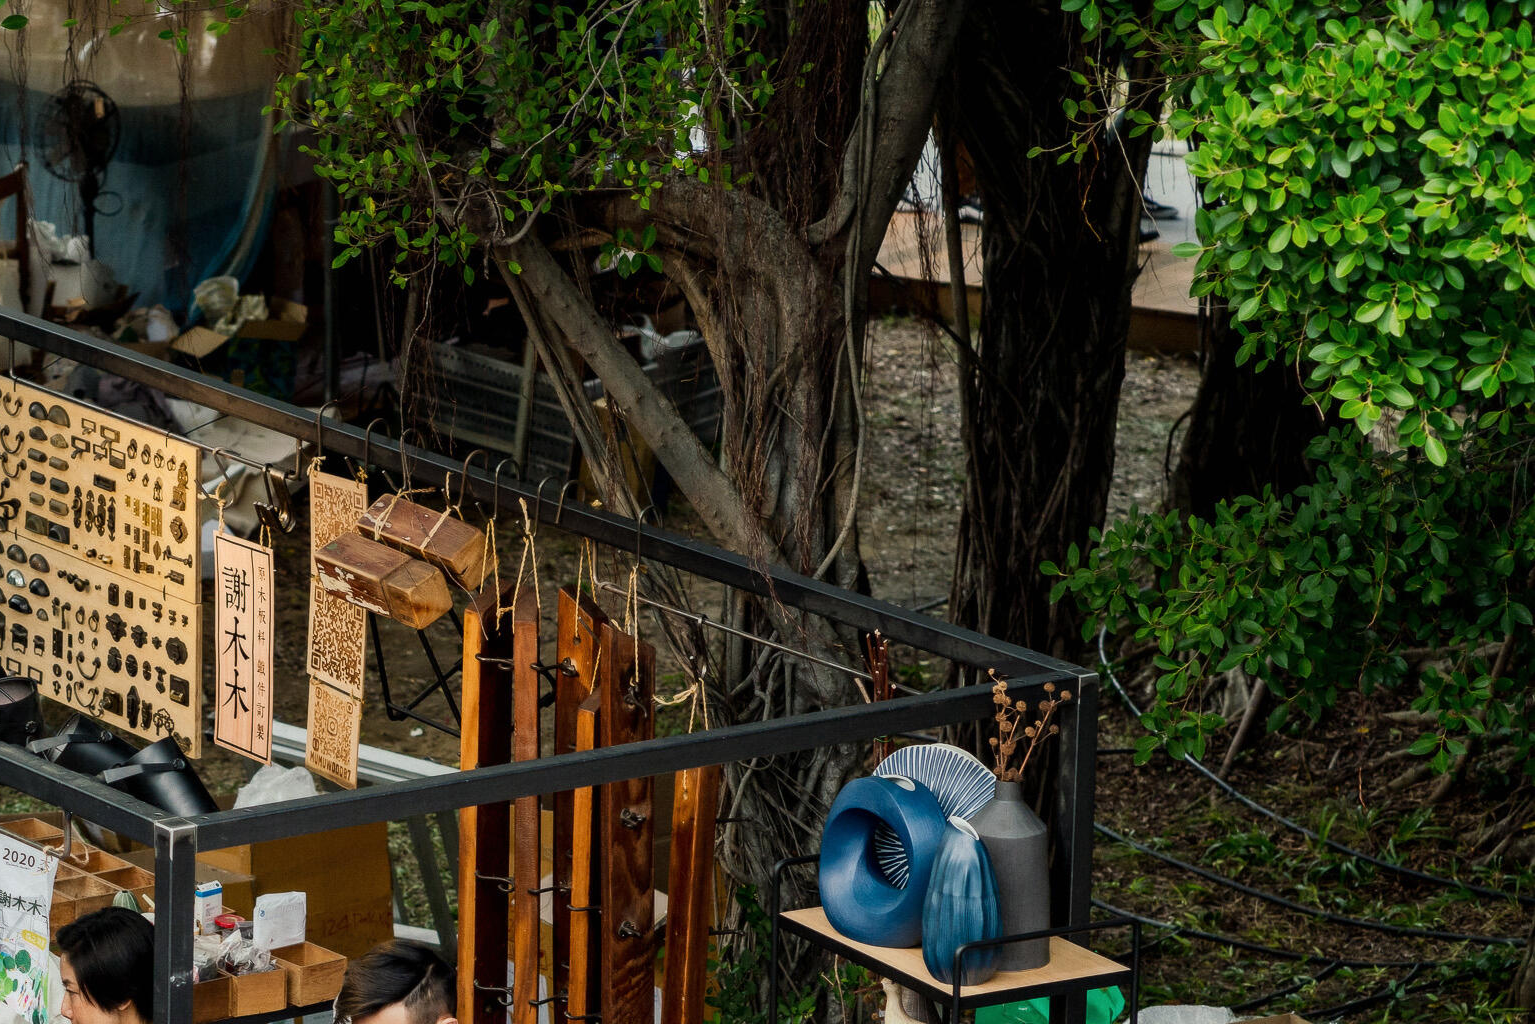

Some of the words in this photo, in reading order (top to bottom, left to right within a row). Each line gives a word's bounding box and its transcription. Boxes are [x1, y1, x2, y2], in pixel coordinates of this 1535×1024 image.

[222, 566, 250, 719] 謝木木
[3, 848, 35, 867] 2020
[0, 889, 42, 915] 謝木木
